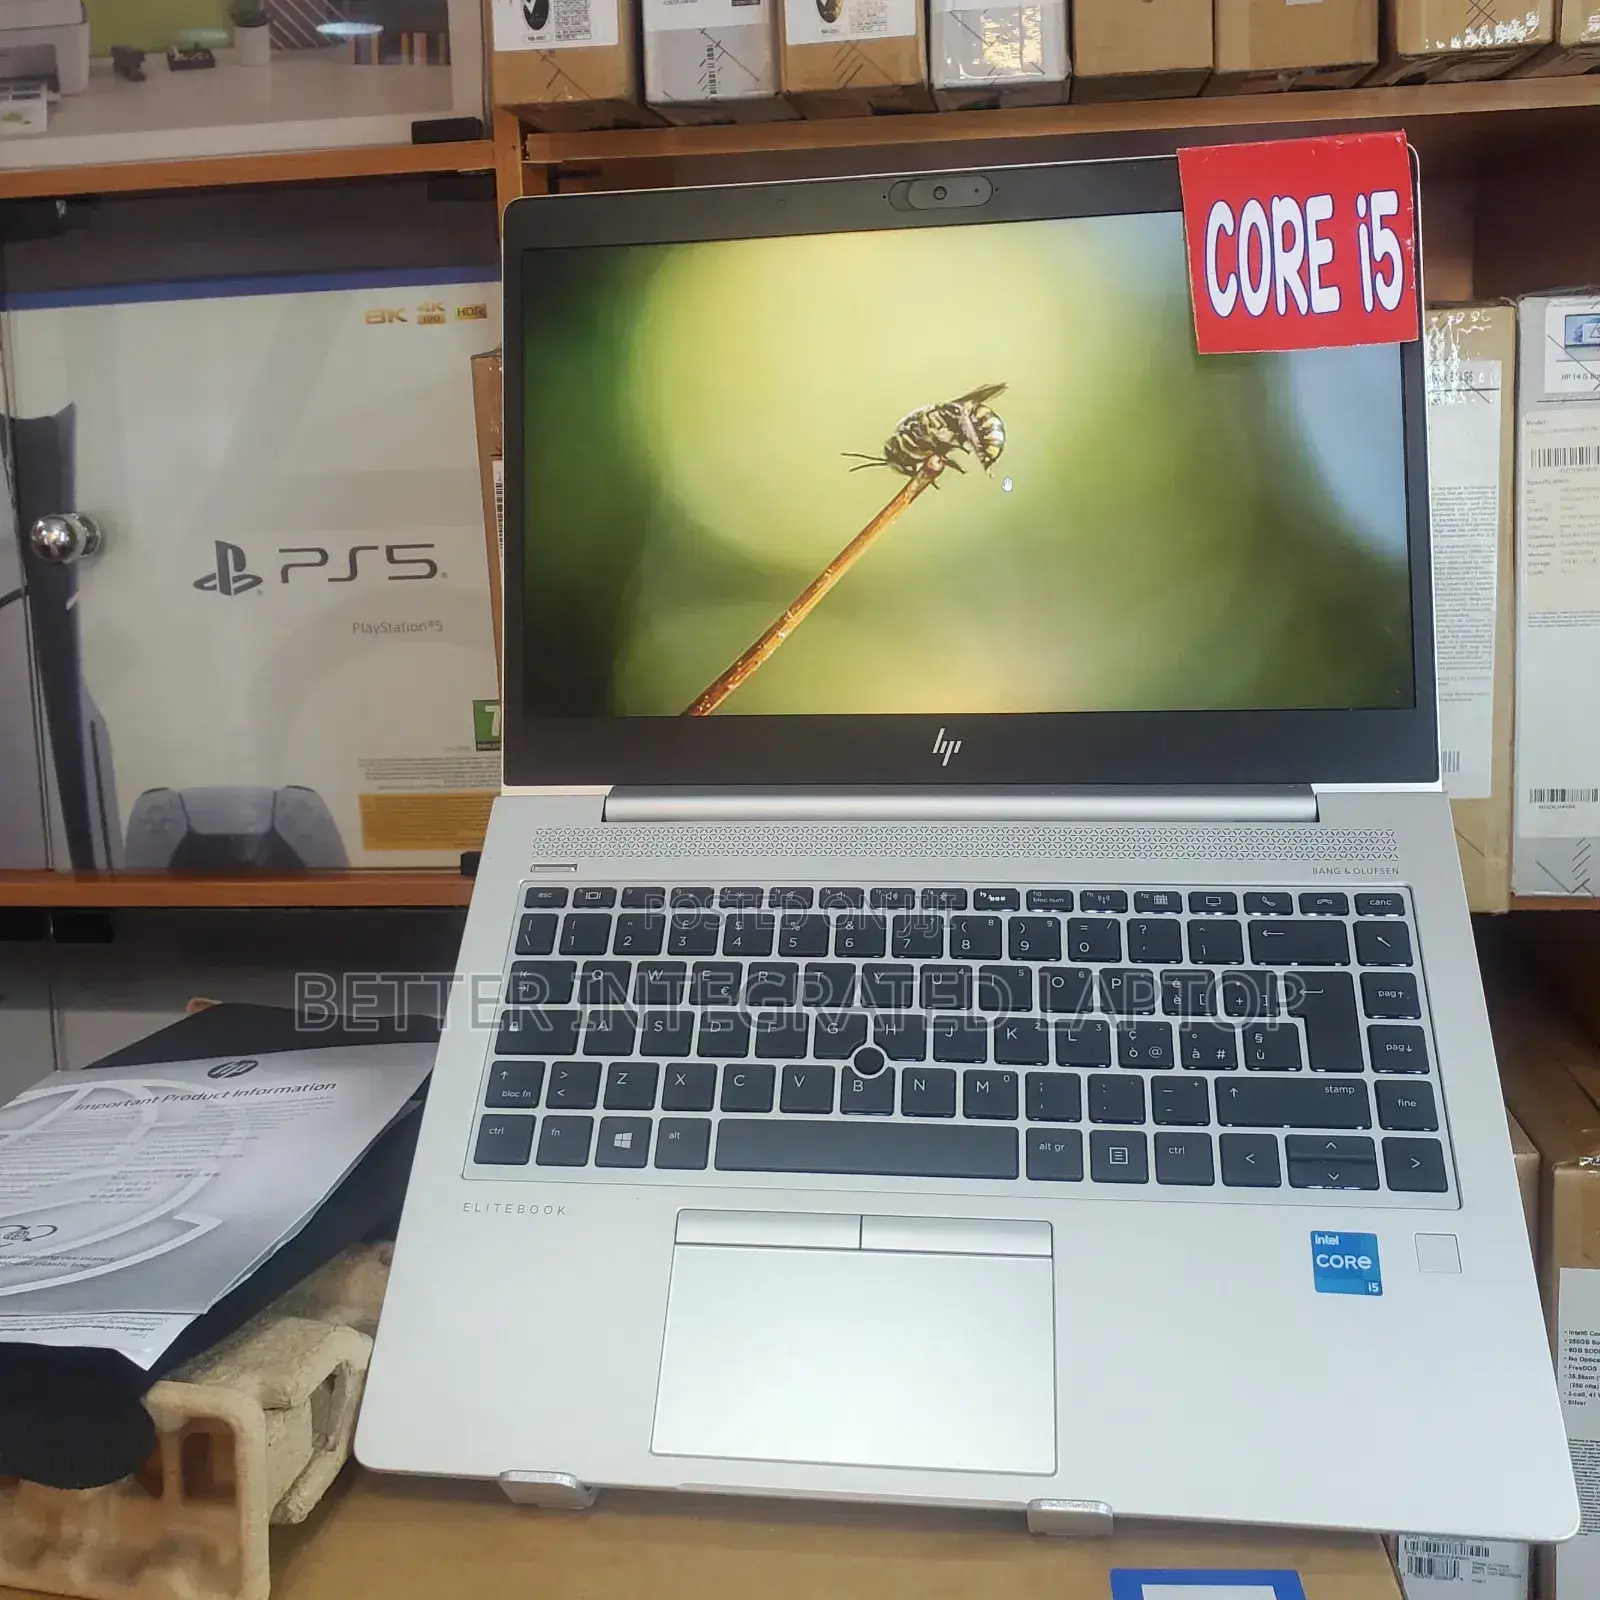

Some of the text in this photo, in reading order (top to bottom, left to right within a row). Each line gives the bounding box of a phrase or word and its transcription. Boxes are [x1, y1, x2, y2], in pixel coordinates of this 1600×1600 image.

[1204, 188, 1404, 318] CORE i5
[416, 302, 446, 312] 4K
[456, 306, 484, 317] HDR
[365, 308, 408, 324] 8K
[278, 543, 438, 584] PS5
[932, 728, 962, 766] hp
[1312, 867, 1399, 875] BANG & OLUFSEN
[734, 920, 743, 931] $
[790, 921, 801, 931] %
[845, 920, 855, 931] &
[962, 922, 967, 933] (
[988, 919, 994, 927] 8
[1020, 922, 1026, 934] )
[1046, 920, 1053, 928] 9
[1139, 924, 1147, 934] ?
[570, 936, 575, 946] 1
[623, 936, 632, 946] 2
[678, 936, 687, 946] 3
[732, 936, 742, 946] 4
[788, 938, 797, 948] 5
[845, 938, 854, 948] 6
[903, 938, 911, 949] 7
[962, 940, 970, 950] 8
[1020, 940, 1030, 951] 9
[1079, 942, 1090, 952] 0
[592, 969, 604, 981] Q
[648, 970, 664, 980] W
[702, 970, 712, 981] E
[758, 971, 768, 982] R
[814, 972, 824, 982] T
[958, 968, 965, 976] 4
[1078, 971, 1085, 979] 6
[874, 973, 884, 984] Y
[932, 973, 942, 985] U
[1052, 976, 1064, 988] O
[1111, 978, 1122, 990] P
[720, 986, 730, 996] €
[1378, 990, 1396, 998] pag
[598, 1021, 609, 1032] A
[654, 1021, 664, 1032] S
[710, 1021, 722, 1032] D
[768, 1022, 777, 1033] F
[827, 1023, 839, 1034] G
[886, 1024, 896, 1036] H
[1034, 1022, 1041, 1030] 2
[945, 1026, 954, 1038] J
[1006, 1028, 1018, 1040] K
[1068, 1030, 1078, 1042] L
[1128, 1030, 1137, 1041] ç
[1254, 1033, 1263, 1044] §
[1129, 1046, 1138, 1058] ò
[1148, 1046, 1163, 1058] @
[1386, 1043, 1405, 1052] pag
[1192, 1048, 1200, 1059] à
[1216, 1048, 1226, 1060] #
[1256, 1050, 1265, 1060] ù
[616, 1072, 628, 1085] Z
[674, 1074, 687, 1086] X
[734, 1075, 746, 1086] C
[794, 1075, 805, 1088] V
[853, 1080, 864, 1092] B
[914, 1079, 926, 1091] N
[976, 1080, 989, 1093] M
[1324, 1086, 1355, 1095] stamp
[74, 1082, 338, 1112] Important Product Information
[501, 1090, 532, 1098] bloc fn
[1397, 1098, 1417, 1107] fine
[488, 1127, 504, 1135] ctrl
[550, 1128, 560, 1136] fn
[668, 1130, 681, 1139] alt
[1039, 1142, 1065, 1152] alt gr
[1168, 1146, 1185, 1154] ctrl
[462, 1202, 567, 1215] ELITEBOOK
[1315, 1234, 1339, 1245] intel
[1568, 1364, 1598, 1372] FreeDOS
